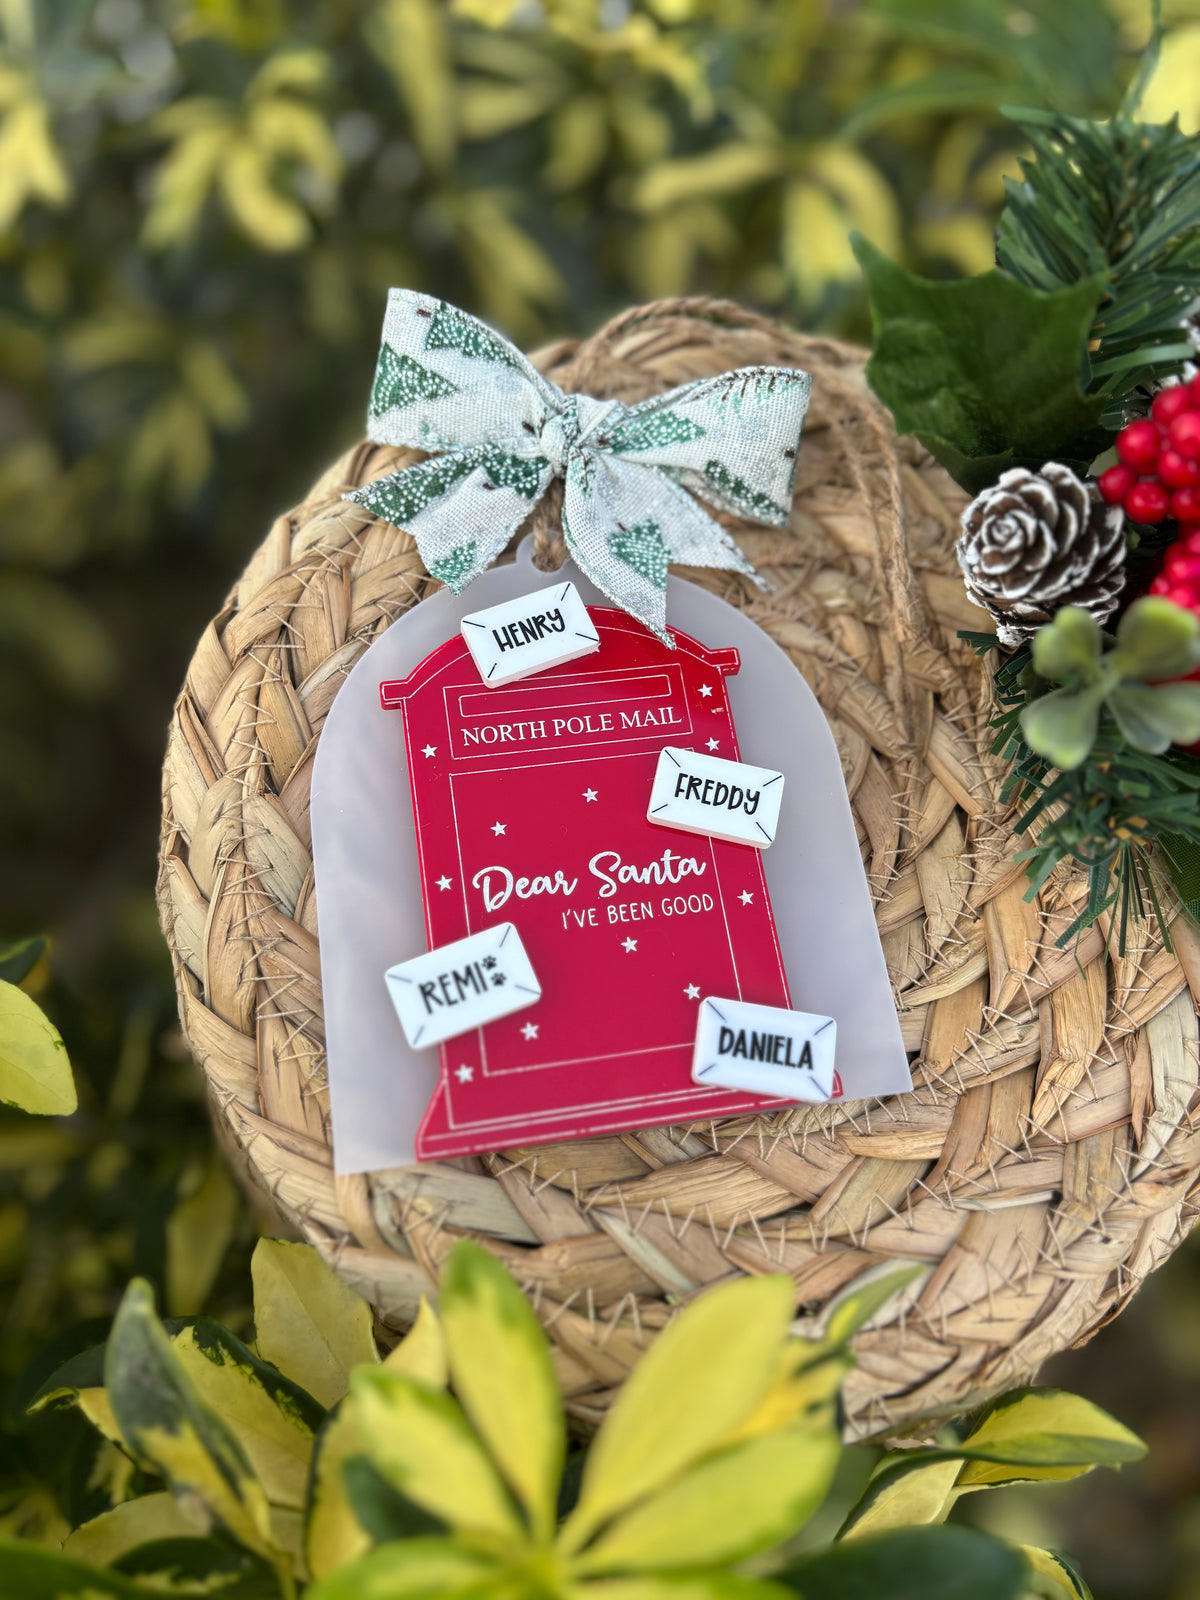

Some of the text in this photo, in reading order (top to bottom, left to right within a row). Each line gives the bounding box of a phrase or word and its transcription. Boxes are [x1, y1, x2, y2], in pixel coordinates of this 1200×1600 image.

[492, 608, 566, 652] HENRY
[460, 707, 682, 746] NORTH POLE MAIL
[674, 773, 761, 815] FREDDY
[472, 849, 706, 912] Dear Santa
[561, 893, 714, 930] I'VE BEEN GOOD
[418, 961, 489, 1015] REMI
[718, 1026, 814, 1071] DANIELA
